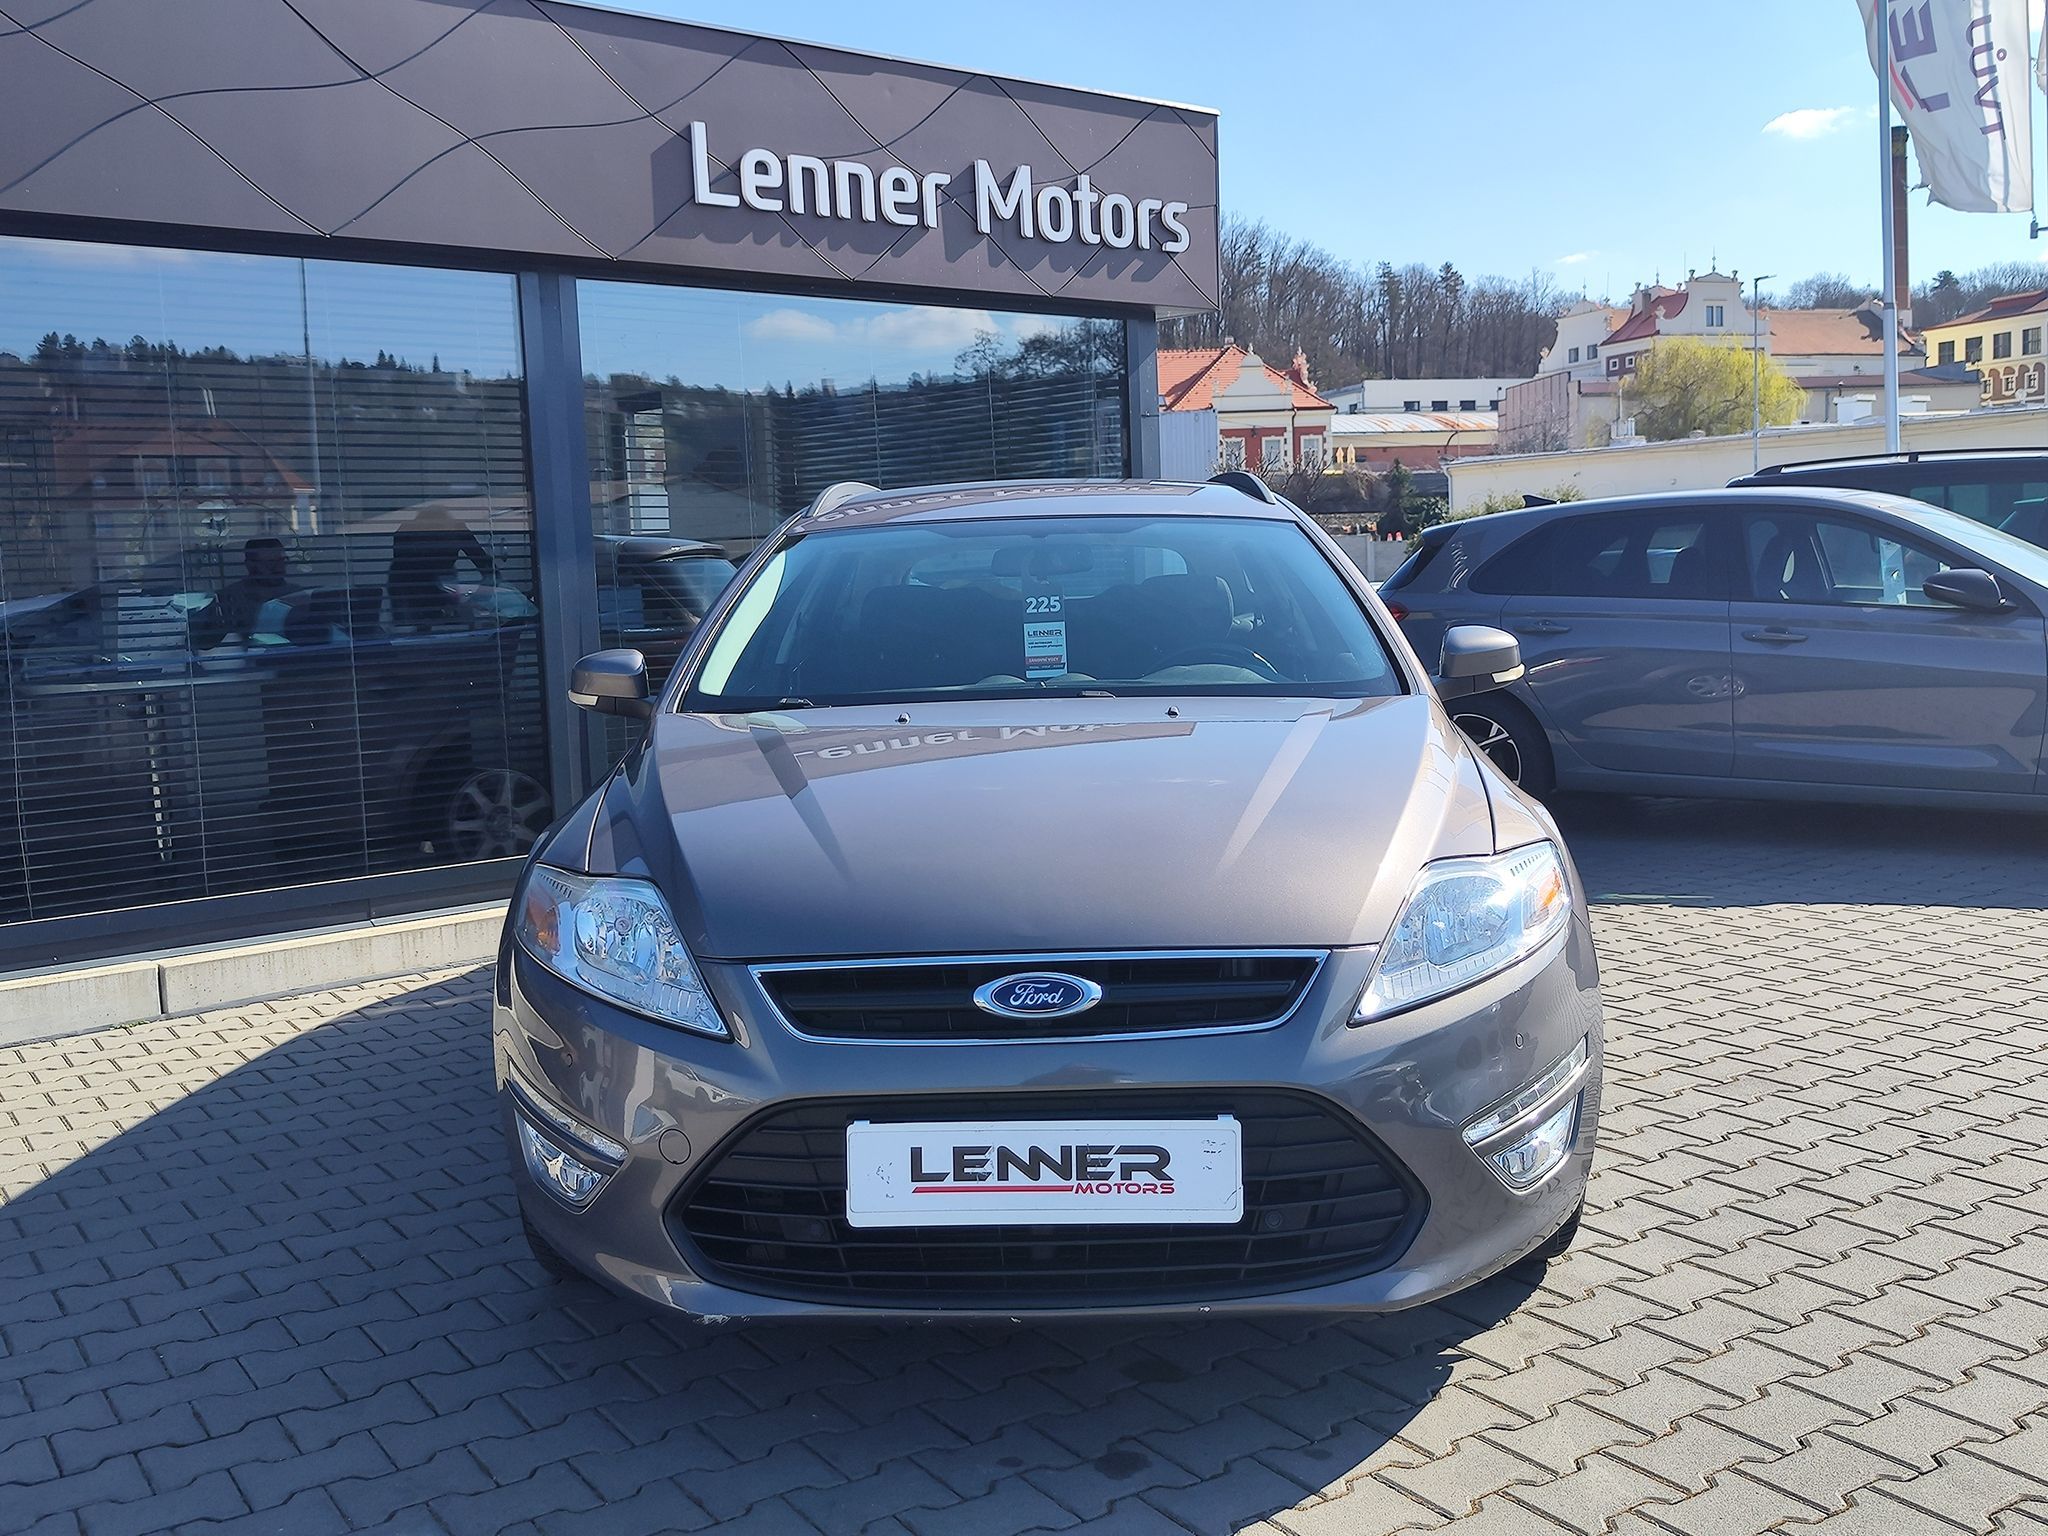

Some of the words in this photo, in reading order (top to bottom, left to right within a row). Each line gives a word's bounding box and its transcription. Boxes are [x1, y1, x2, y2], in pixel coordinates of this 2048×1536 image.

[690, 120, 951, 229] Lenner
[974, 158, 1190, 254] Motors
[1025, 595, 1062, 614] 225
[1027, 629, 1063, 637] LENNER
[1009, 983, 1064, 1006] Ford
[910, 1144, 1175, 1183] LENNER
[1074, 1182, 1176, 1195] MOTORS
